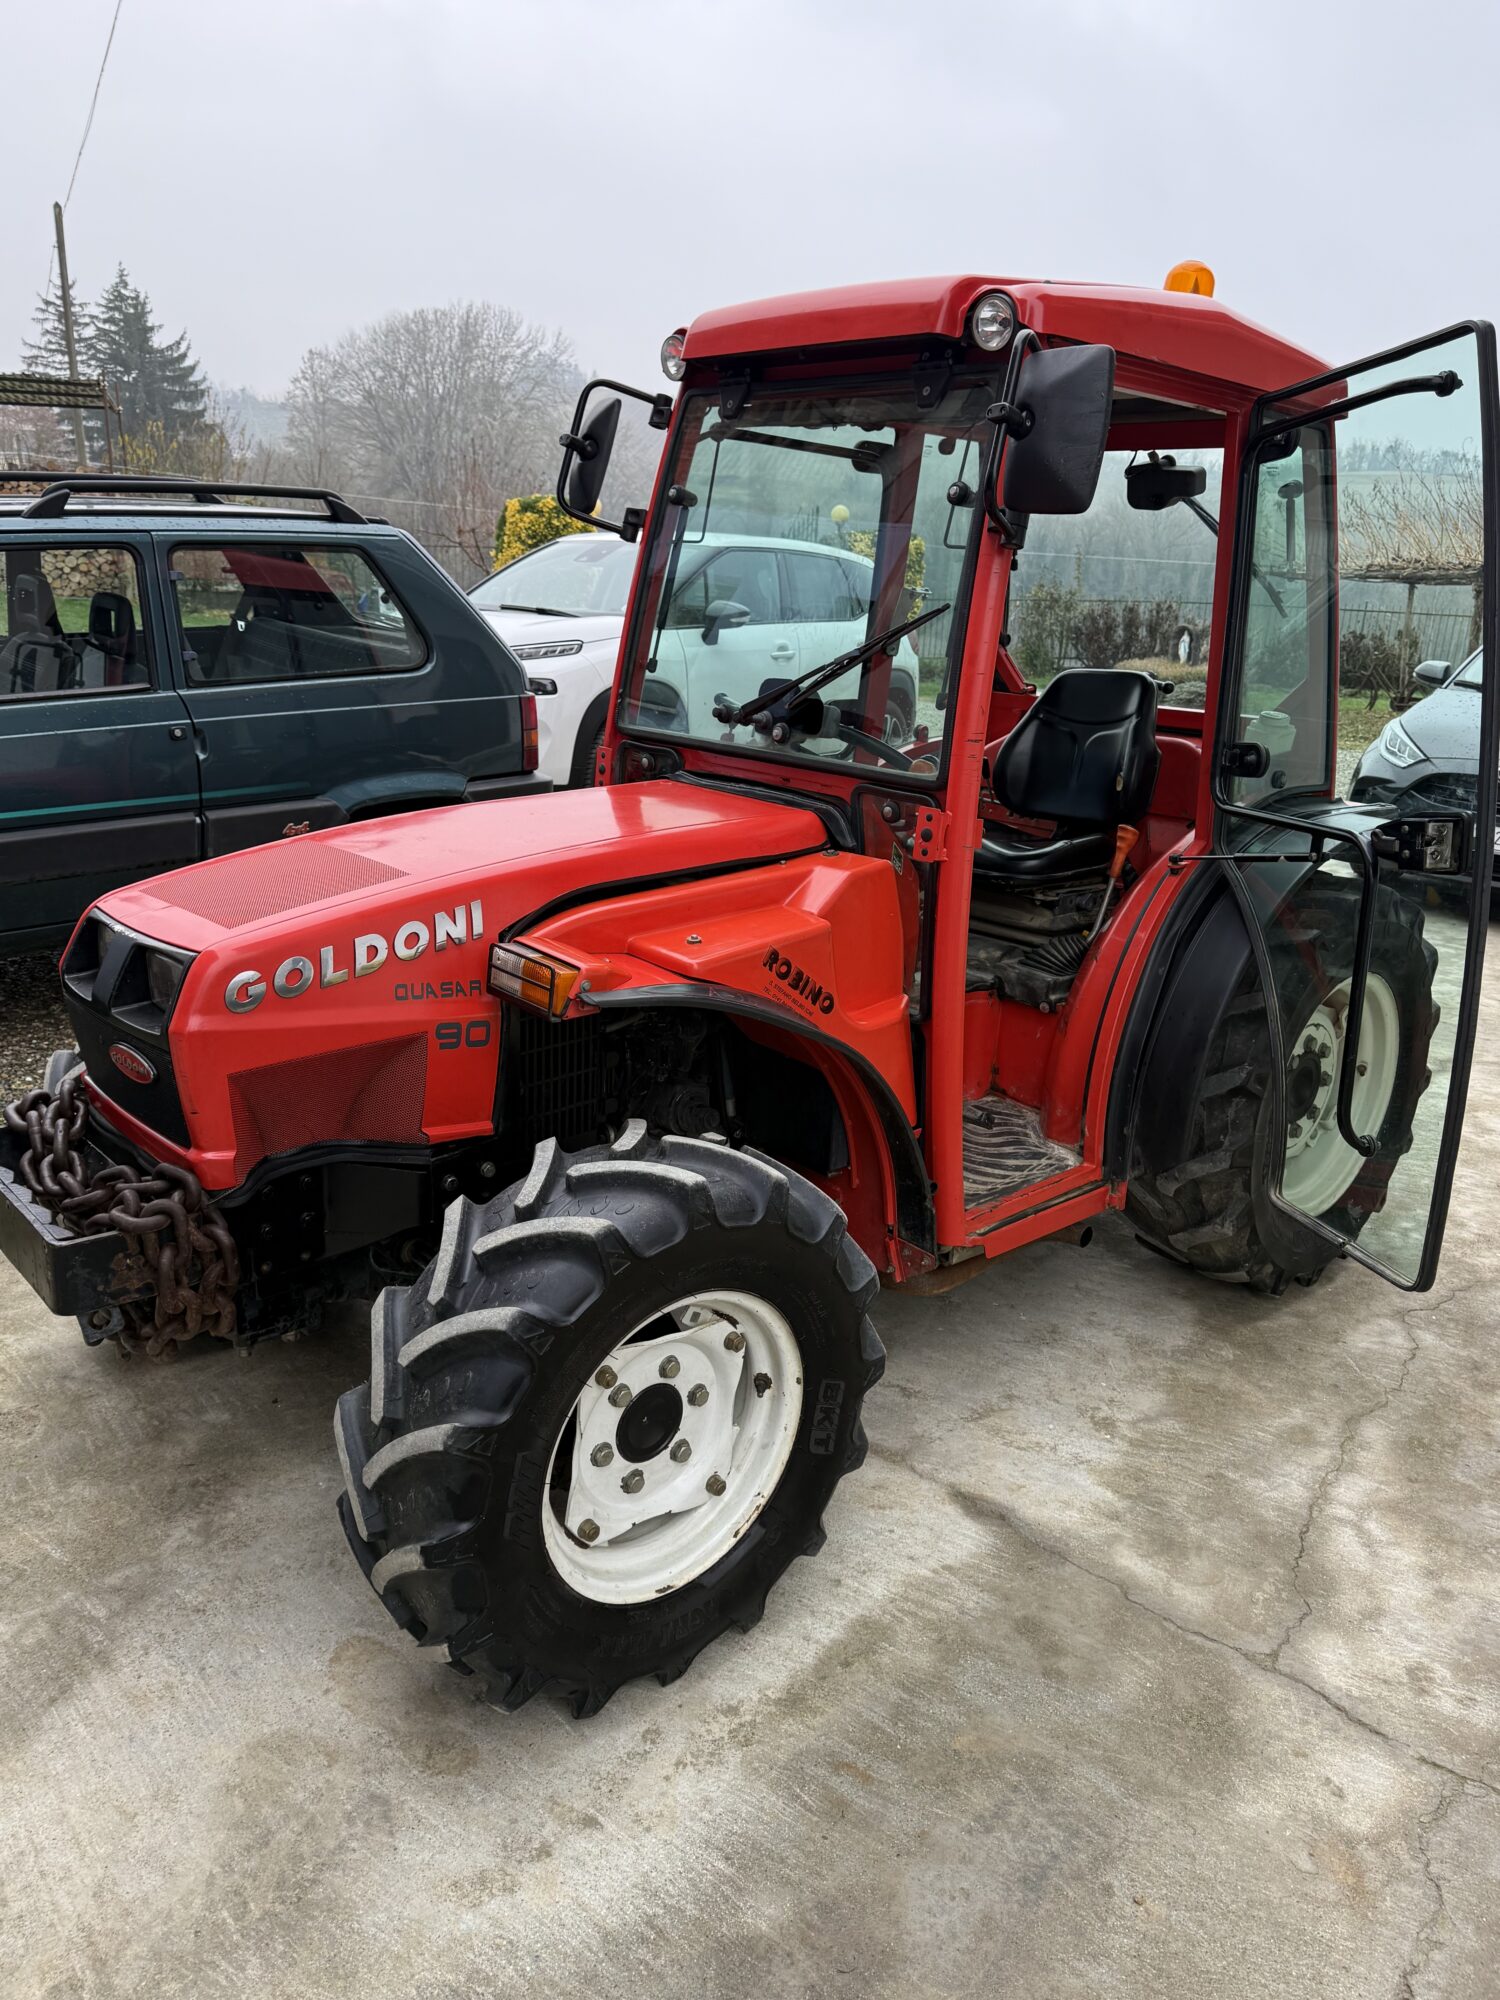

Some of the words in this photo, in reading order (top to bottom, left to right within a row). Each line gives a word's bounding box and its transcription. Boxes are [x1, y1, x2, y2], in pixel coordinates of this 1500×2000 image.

[224, 900, 484, 1014] GOLDONI
[394, 980, 482, 1001] QUASAR
[762, 945, 835, 1014] ROBINO
[435, 1020, 491, 1050] 90
[813, 1378, 845, 1454] BKT
